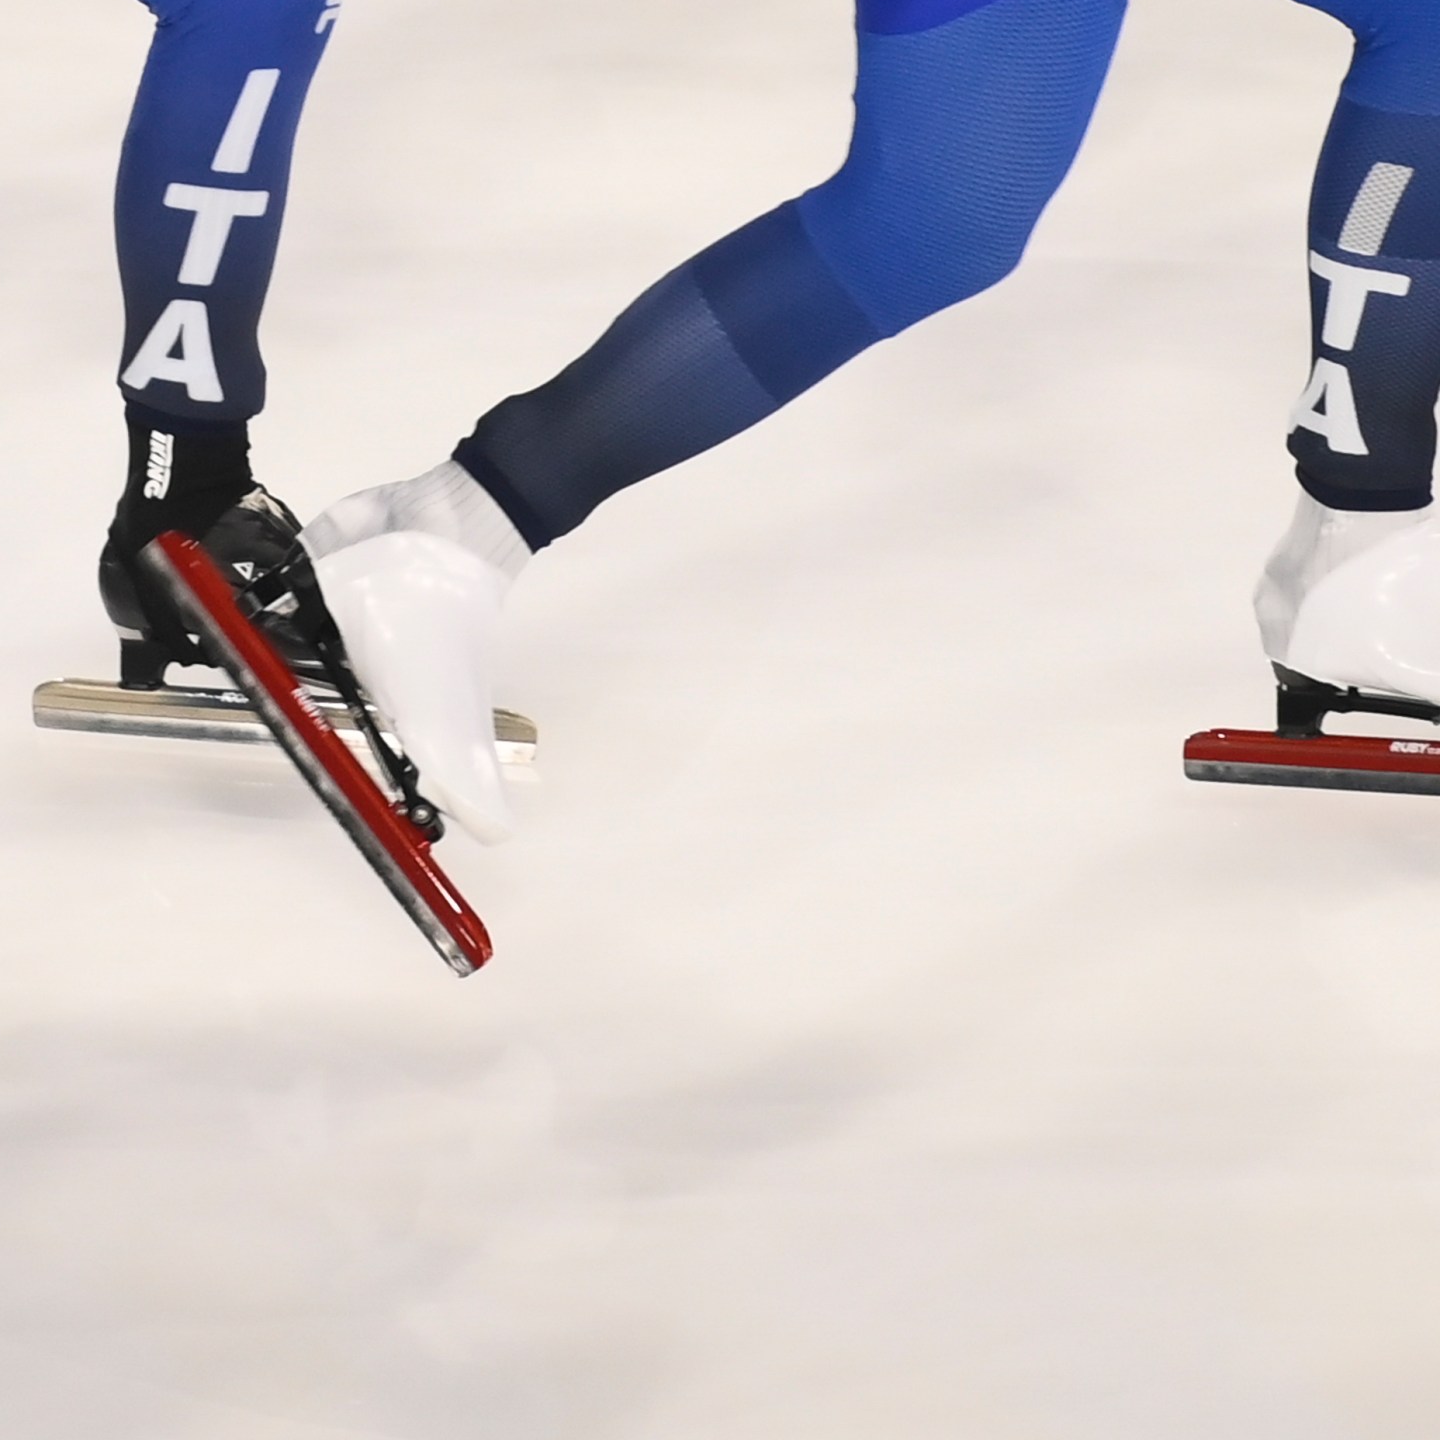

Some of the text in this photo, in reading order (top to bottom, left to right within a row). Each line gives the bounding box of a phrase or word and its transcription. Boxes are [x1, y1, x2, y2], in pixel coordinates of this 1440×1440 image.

[121, 68, 281, 404] ITA
[1288, 162, 1415, 456] ITA
[143, 429, 175, 500] IKING
